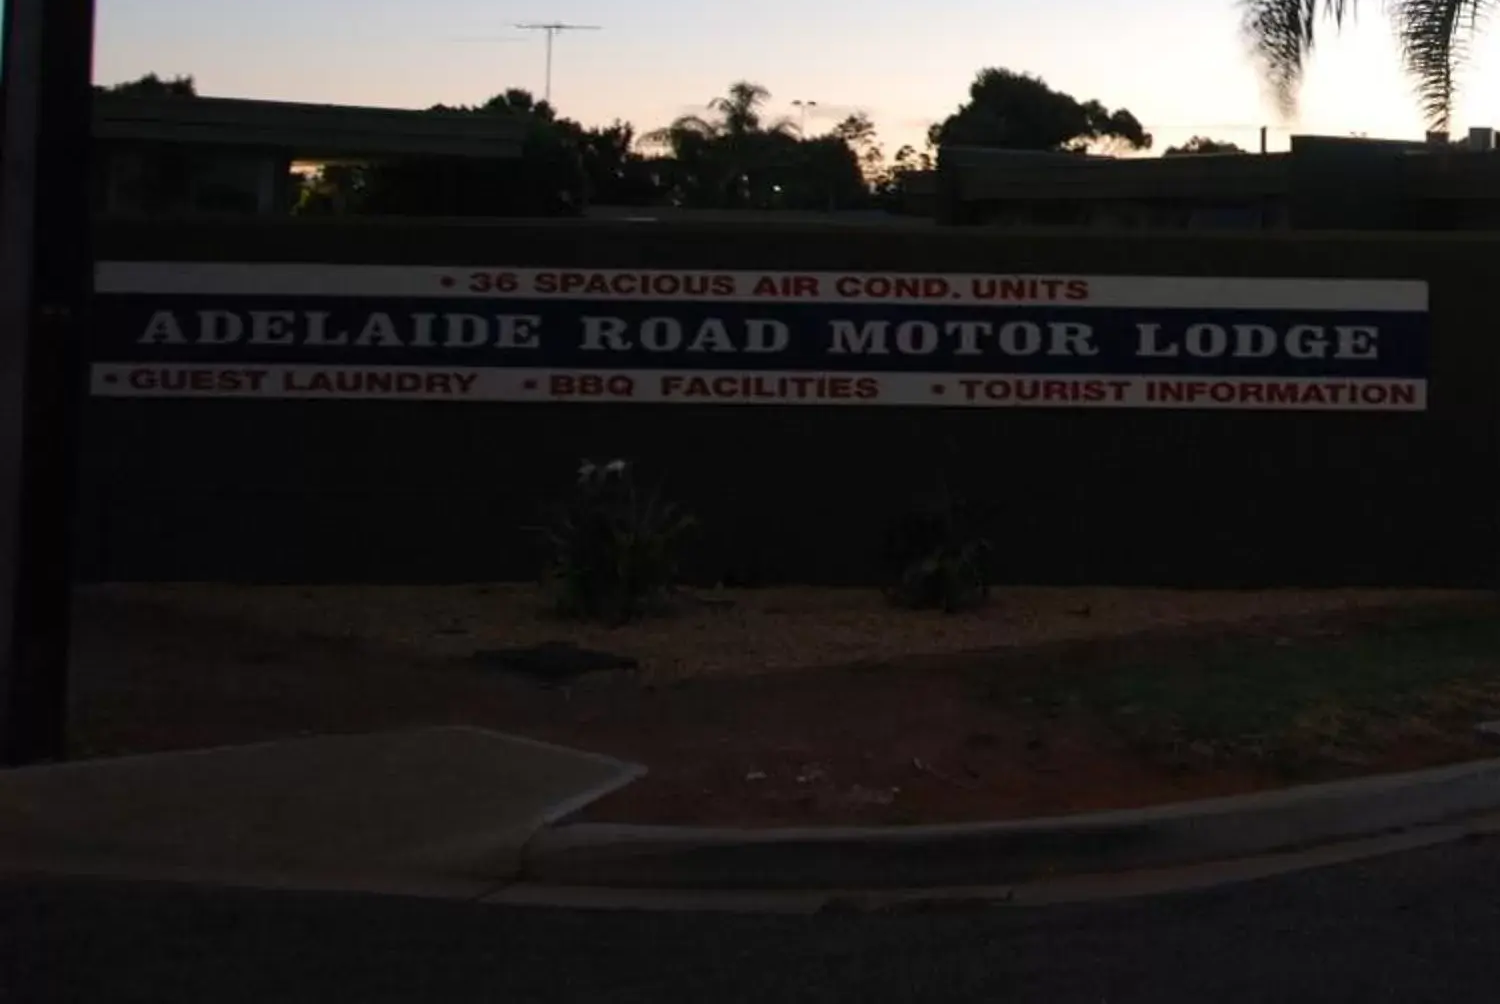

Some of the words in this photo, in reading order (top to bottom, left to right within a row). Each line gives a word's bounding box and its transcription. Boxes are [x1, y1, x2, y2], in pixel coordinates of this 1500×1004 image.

[468, 273, 518, 293] 36
[534, 273, 735, 296] SPACIOUS
[753, 277, 820, 297] AIR
[835, 277, 961, 299] COND.
[972, 279, 1089, 300] UNITS
[137, 309, 541, 349] ADELAIDE
[579, 315, 790, 352] ROAD
[827, 320, 1099, 357] MOTOR
[1135, 323, 1379, 360] LODGE
[128, 368, 267, 390] GUEST
[284, 370, 479, 394] LAUNDRY
[550, 375, 635, 396] BBQ
[660, 376, 879, 399] FACILITIES
[960, 379, 1132, 401] TOURIST
[1146, 382, 1415, 405] INFORMATION
